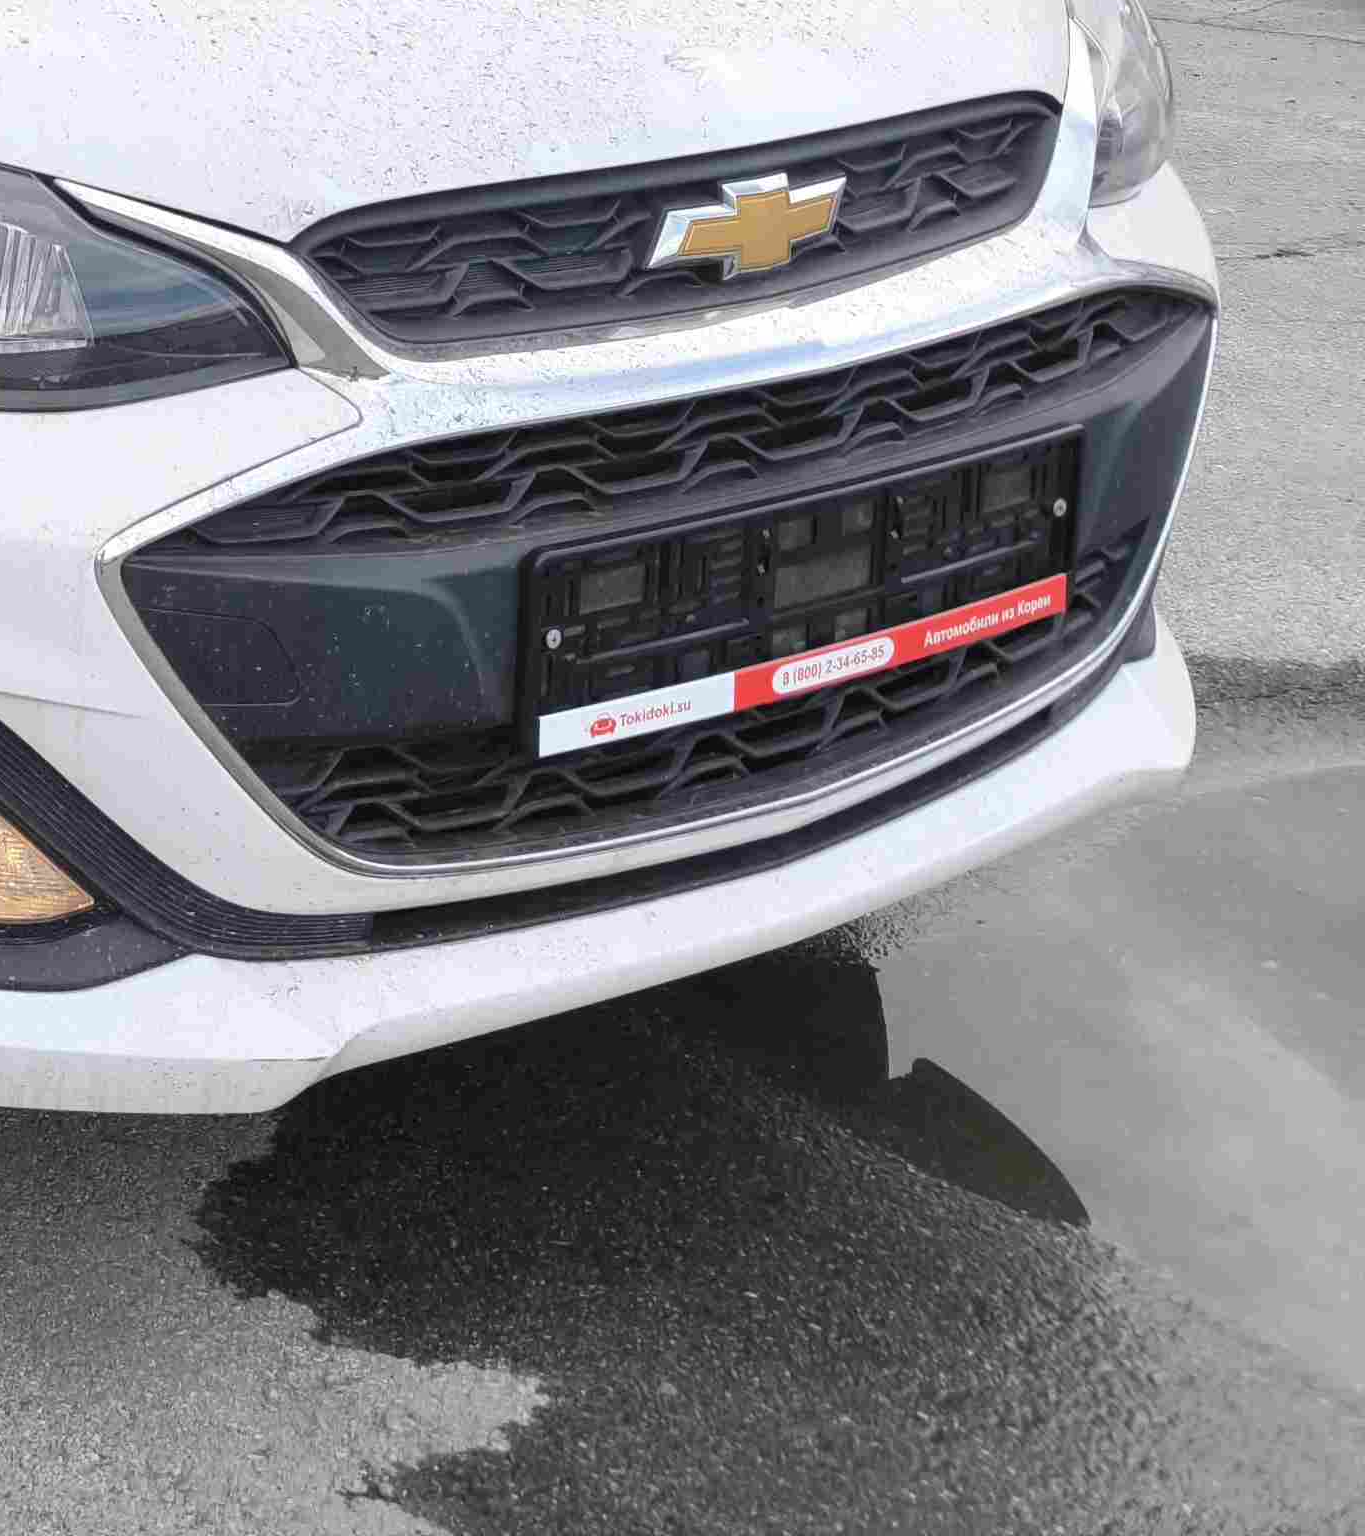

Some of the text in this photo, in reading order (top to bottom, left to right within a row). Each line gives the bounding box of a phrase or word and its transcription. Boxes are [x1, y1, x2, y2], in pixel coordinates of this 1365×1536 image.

[923, 594, 1052, 648] Автомобили из Кореи
[619, 699, 692, 727] Tokidoki.su
